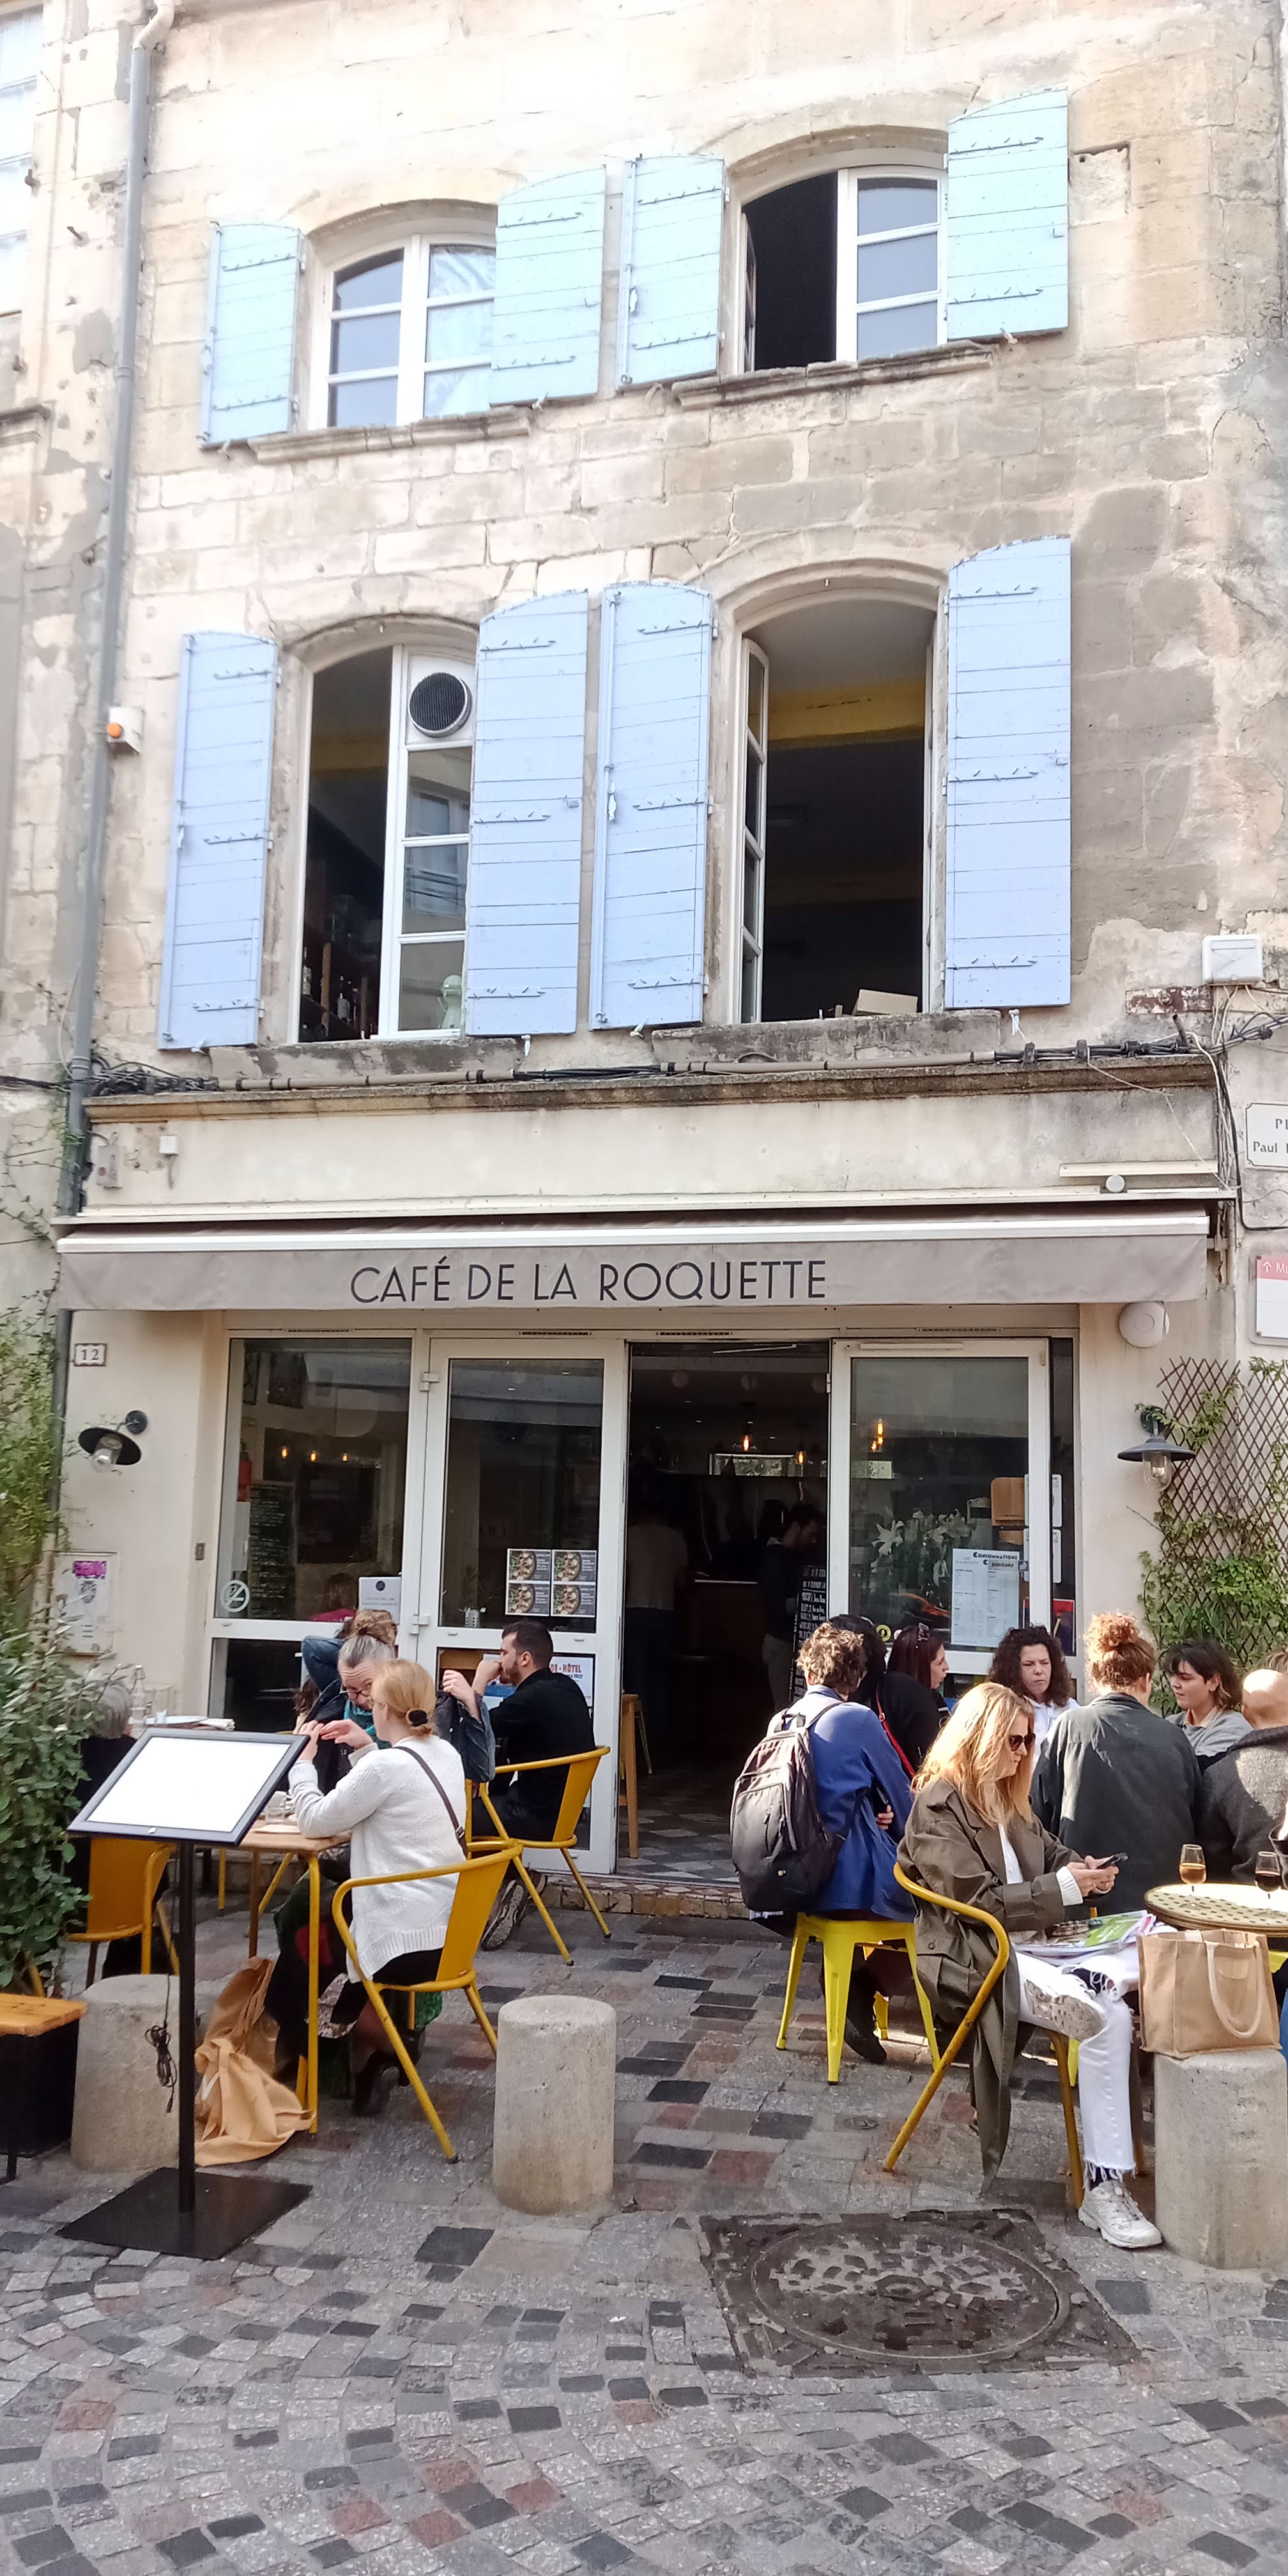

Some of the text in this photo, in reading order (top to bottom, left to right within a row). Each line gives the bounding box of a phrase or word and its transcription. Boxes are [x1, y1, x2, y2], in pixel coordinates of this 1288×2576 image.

[1253, 1141, 1278, 1153] Paul
[351, 1255, 825, 1303] CAFÉ DE LA ROQUETTE
[82, 1349, 98, 1360] 12
